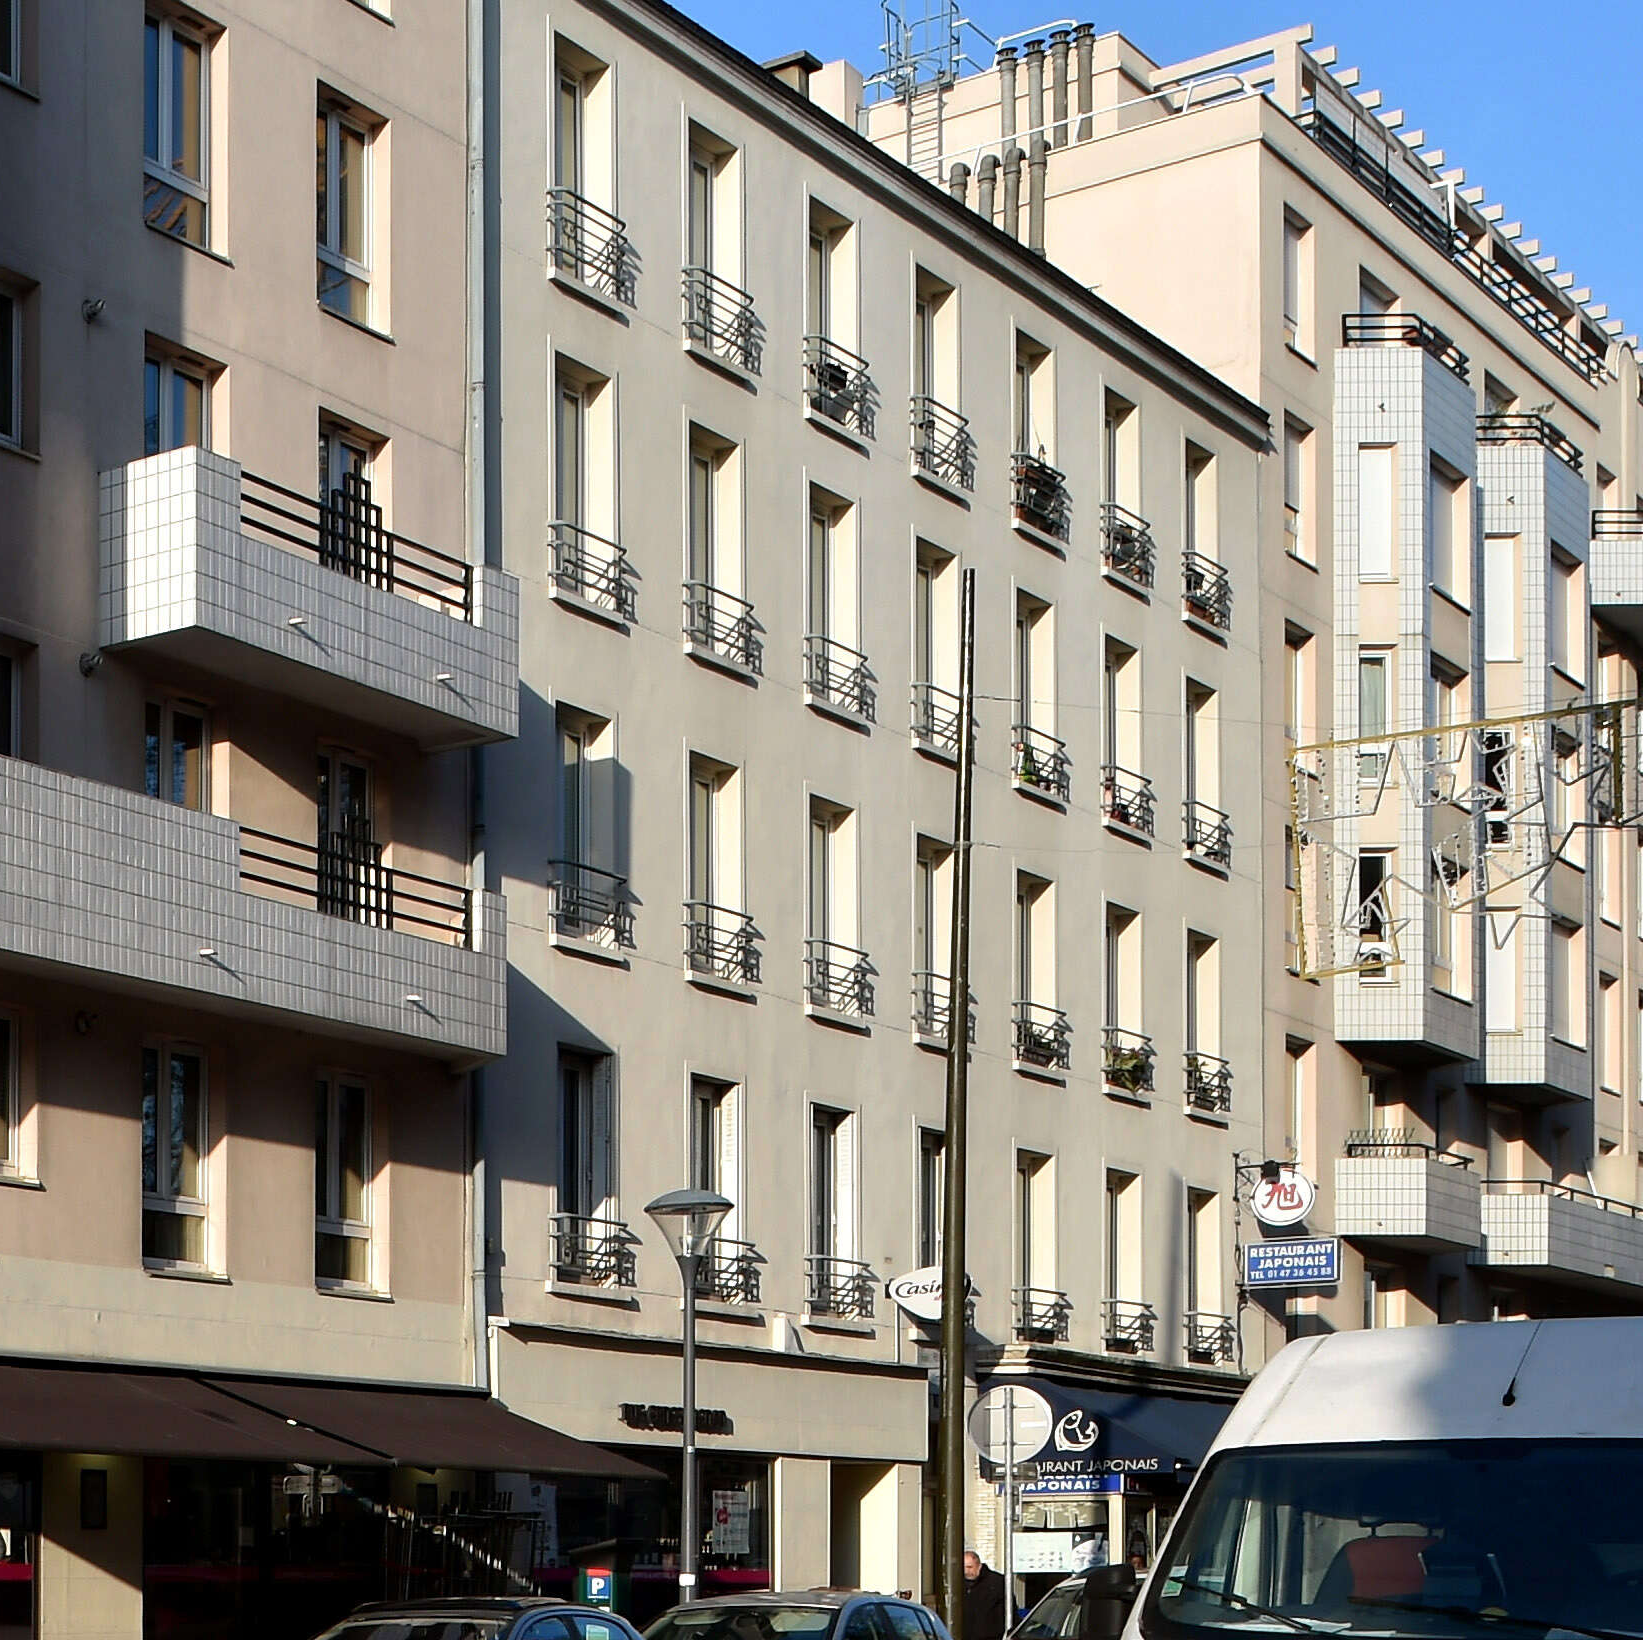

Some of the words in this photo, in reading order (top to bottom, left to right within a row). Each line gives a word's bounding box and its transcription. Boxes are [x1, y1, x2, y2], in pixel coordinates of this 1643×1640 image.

[1262, 1183, 1303, 1210] 旭
[1250, 1244, 1333, 1258] RESTAURANT
[1258, 1256, 1327, 1269] JAPONAIS
[1268, 1269, 1277, 1278] 01
[1280, 1269, 1291, 1278] 47
[895, 1280, 943, 1298] Casi
[1087, 1458, 1159, 1473] JAPONAIS
[591, 1577, 605, 1595] P
